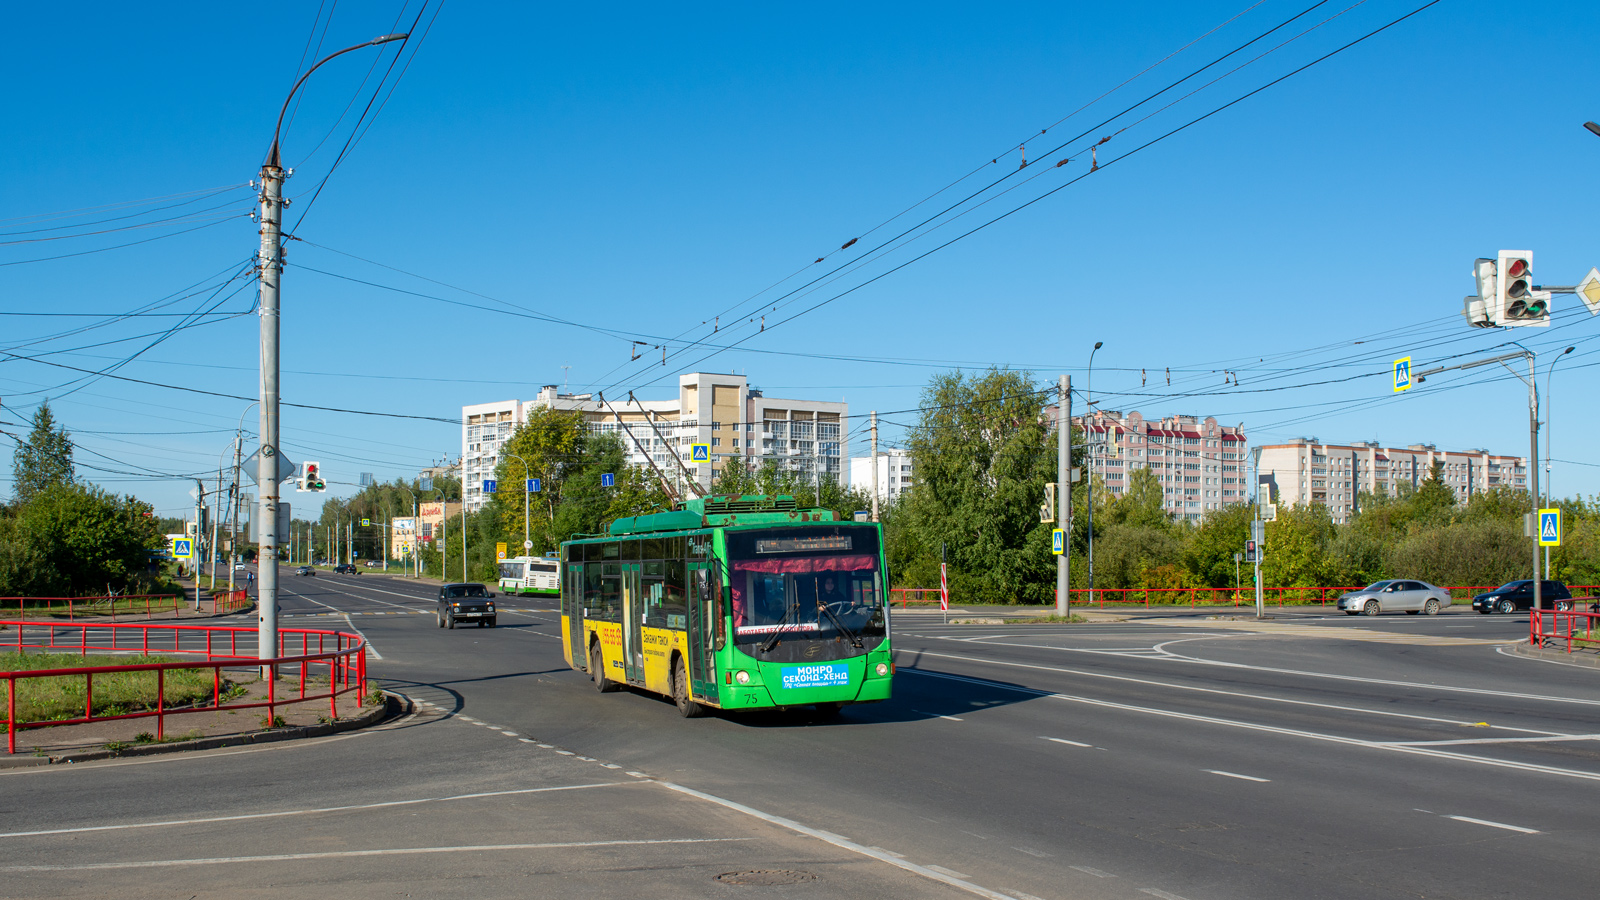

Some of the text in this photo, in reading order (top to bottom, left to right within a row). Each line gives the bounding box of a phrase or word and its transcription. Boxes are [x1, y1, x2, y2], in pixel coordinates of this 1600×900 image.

[797, 665, 833, 675] МОНРО
[783, 672, 848, 683] СЕКОНД-ХЕНД
[744, 692, 758, 705] 75
